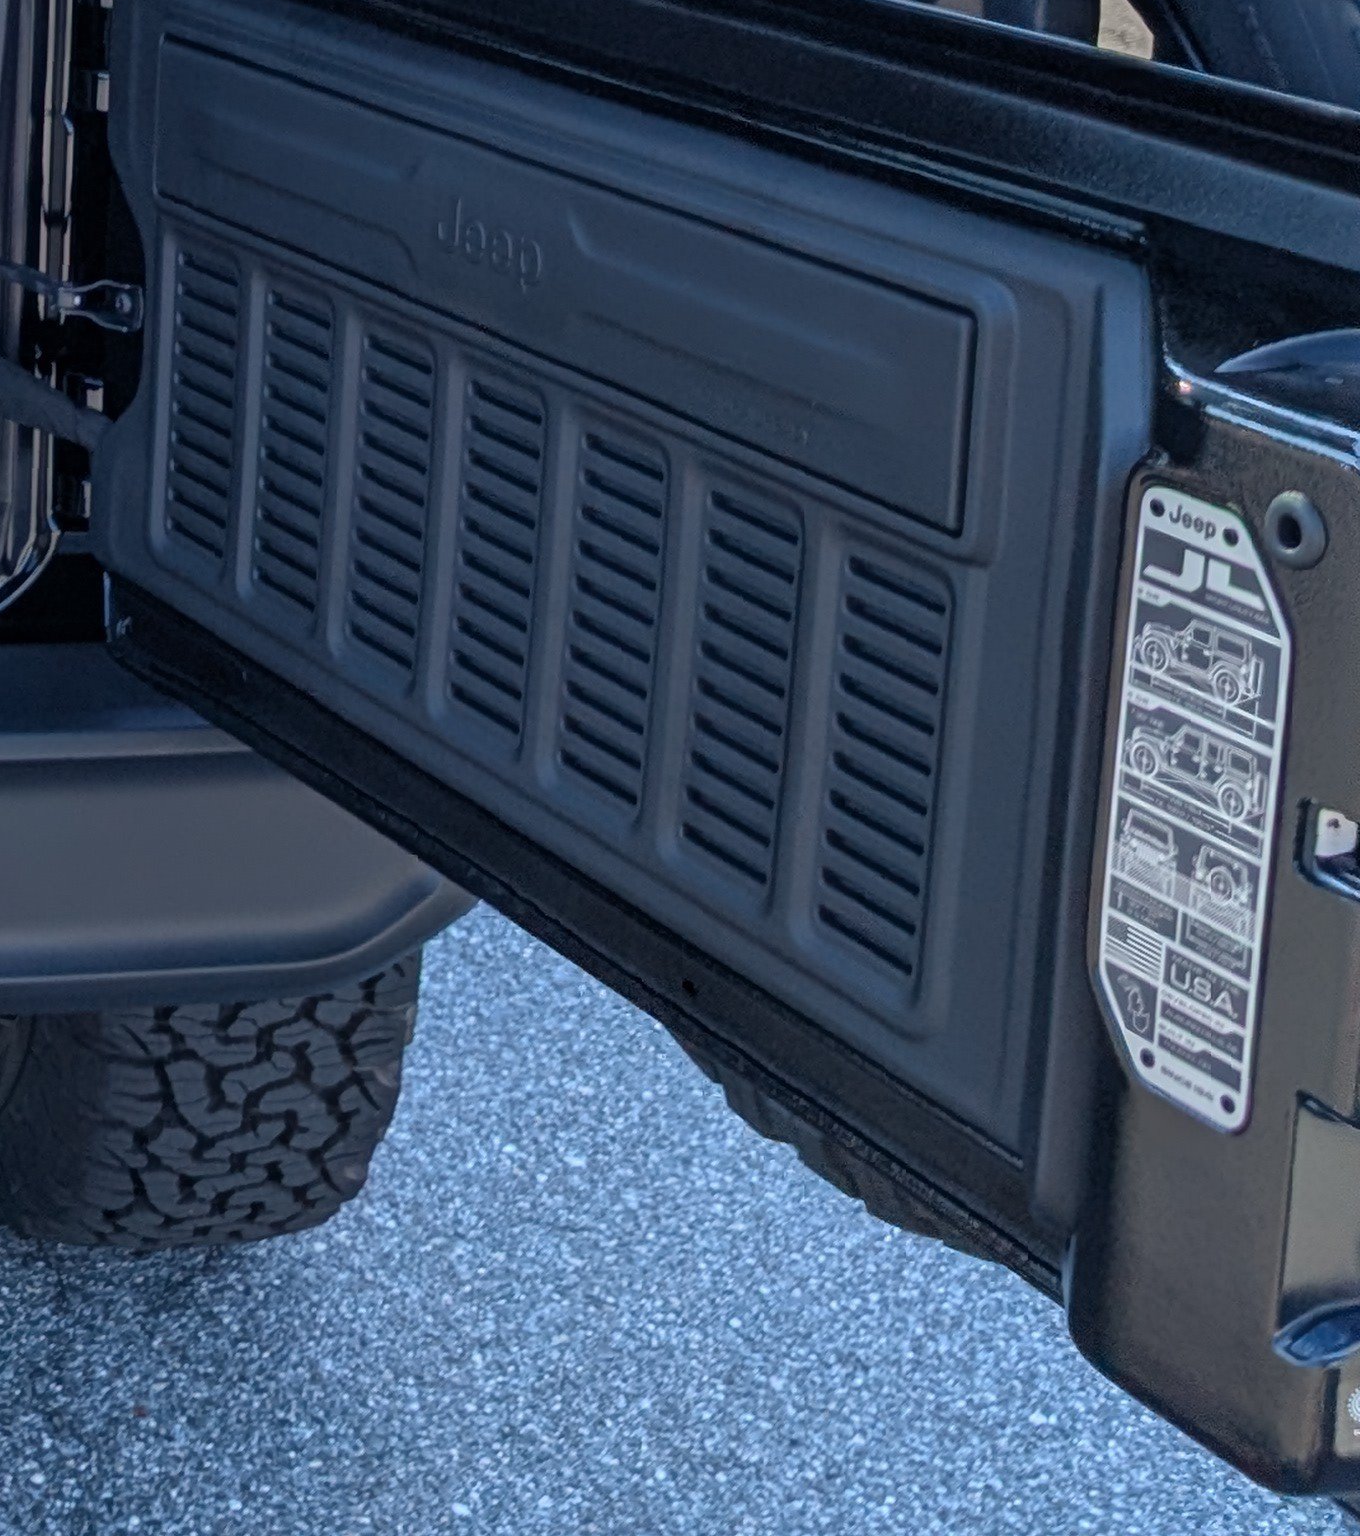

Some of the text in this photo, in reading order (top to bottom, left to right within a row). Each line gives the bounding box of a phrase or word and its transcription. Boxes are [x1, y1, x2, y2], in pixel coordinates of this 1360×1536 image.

[437, 197, 543, 295] Jeep
[1168, 505, 1217, 540] Jeep
[1143, 549, 1265, 611] JL
[1169, 962, 1238, 1019] U.S.A.
